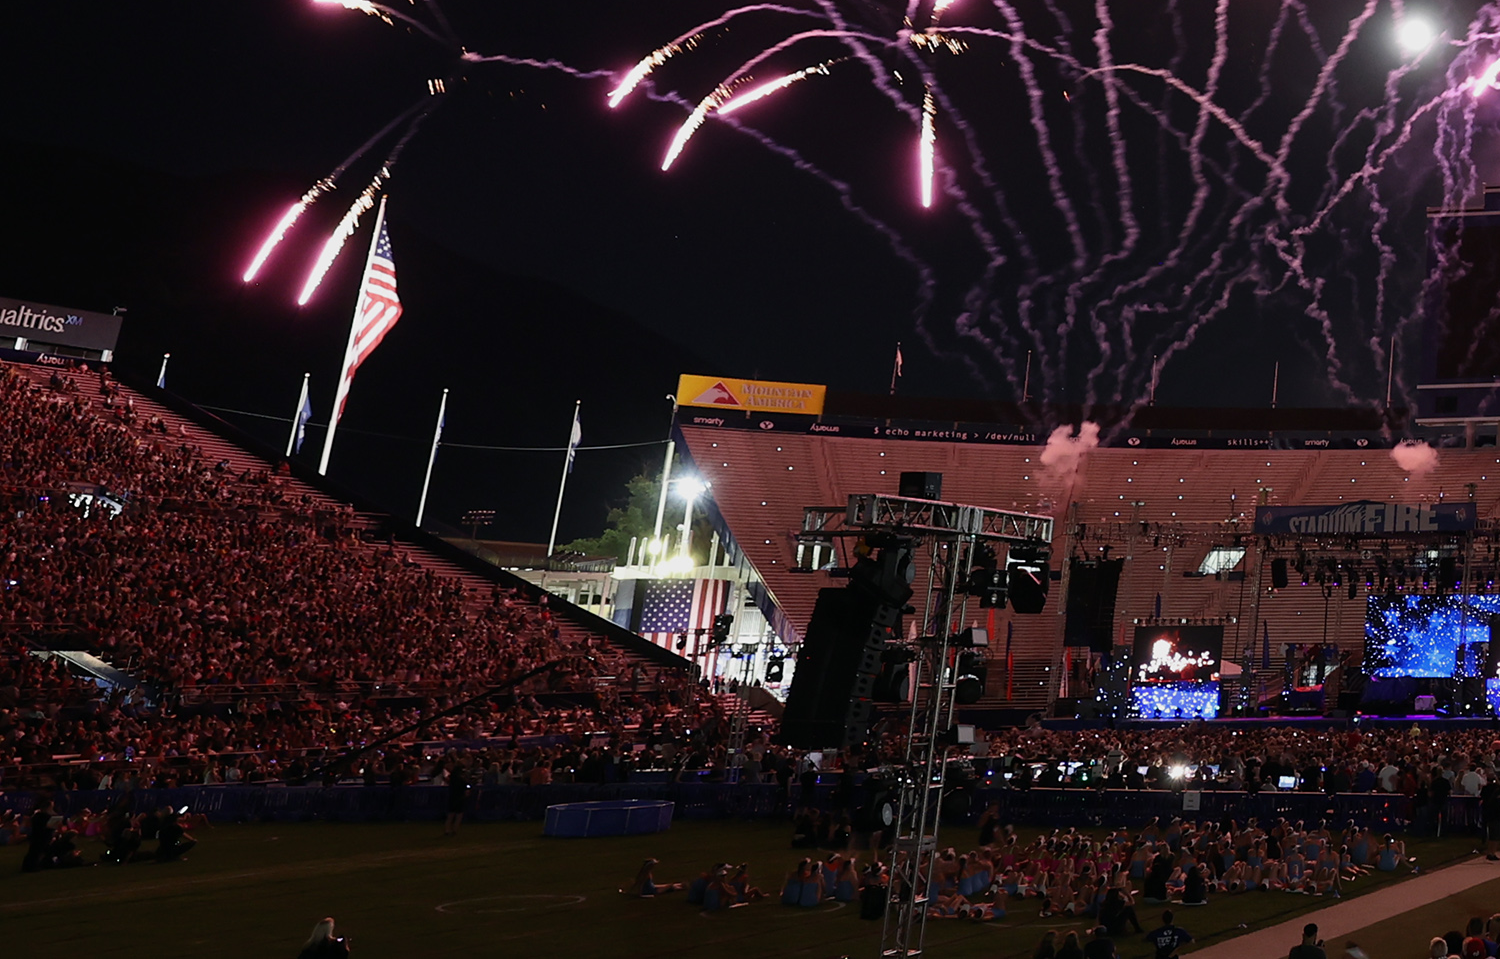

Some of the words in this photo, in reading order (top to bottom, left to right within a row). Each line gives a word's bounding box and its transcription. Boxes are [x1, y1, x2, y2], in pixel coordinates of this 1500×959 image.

[741, 383, 814, 399] MOUNTAIN
[745, 396, 807, 410] AMERICA
[693, 416, 725, 427] smarty
[885, 428, 910, 437] echo
[914, 429, 968, 440] marketing
[985, 432, 1037, 442] /dev/null
[1304, 438, 1331, 448] smarty
[1364, 503, 1439, 532] FIRE
